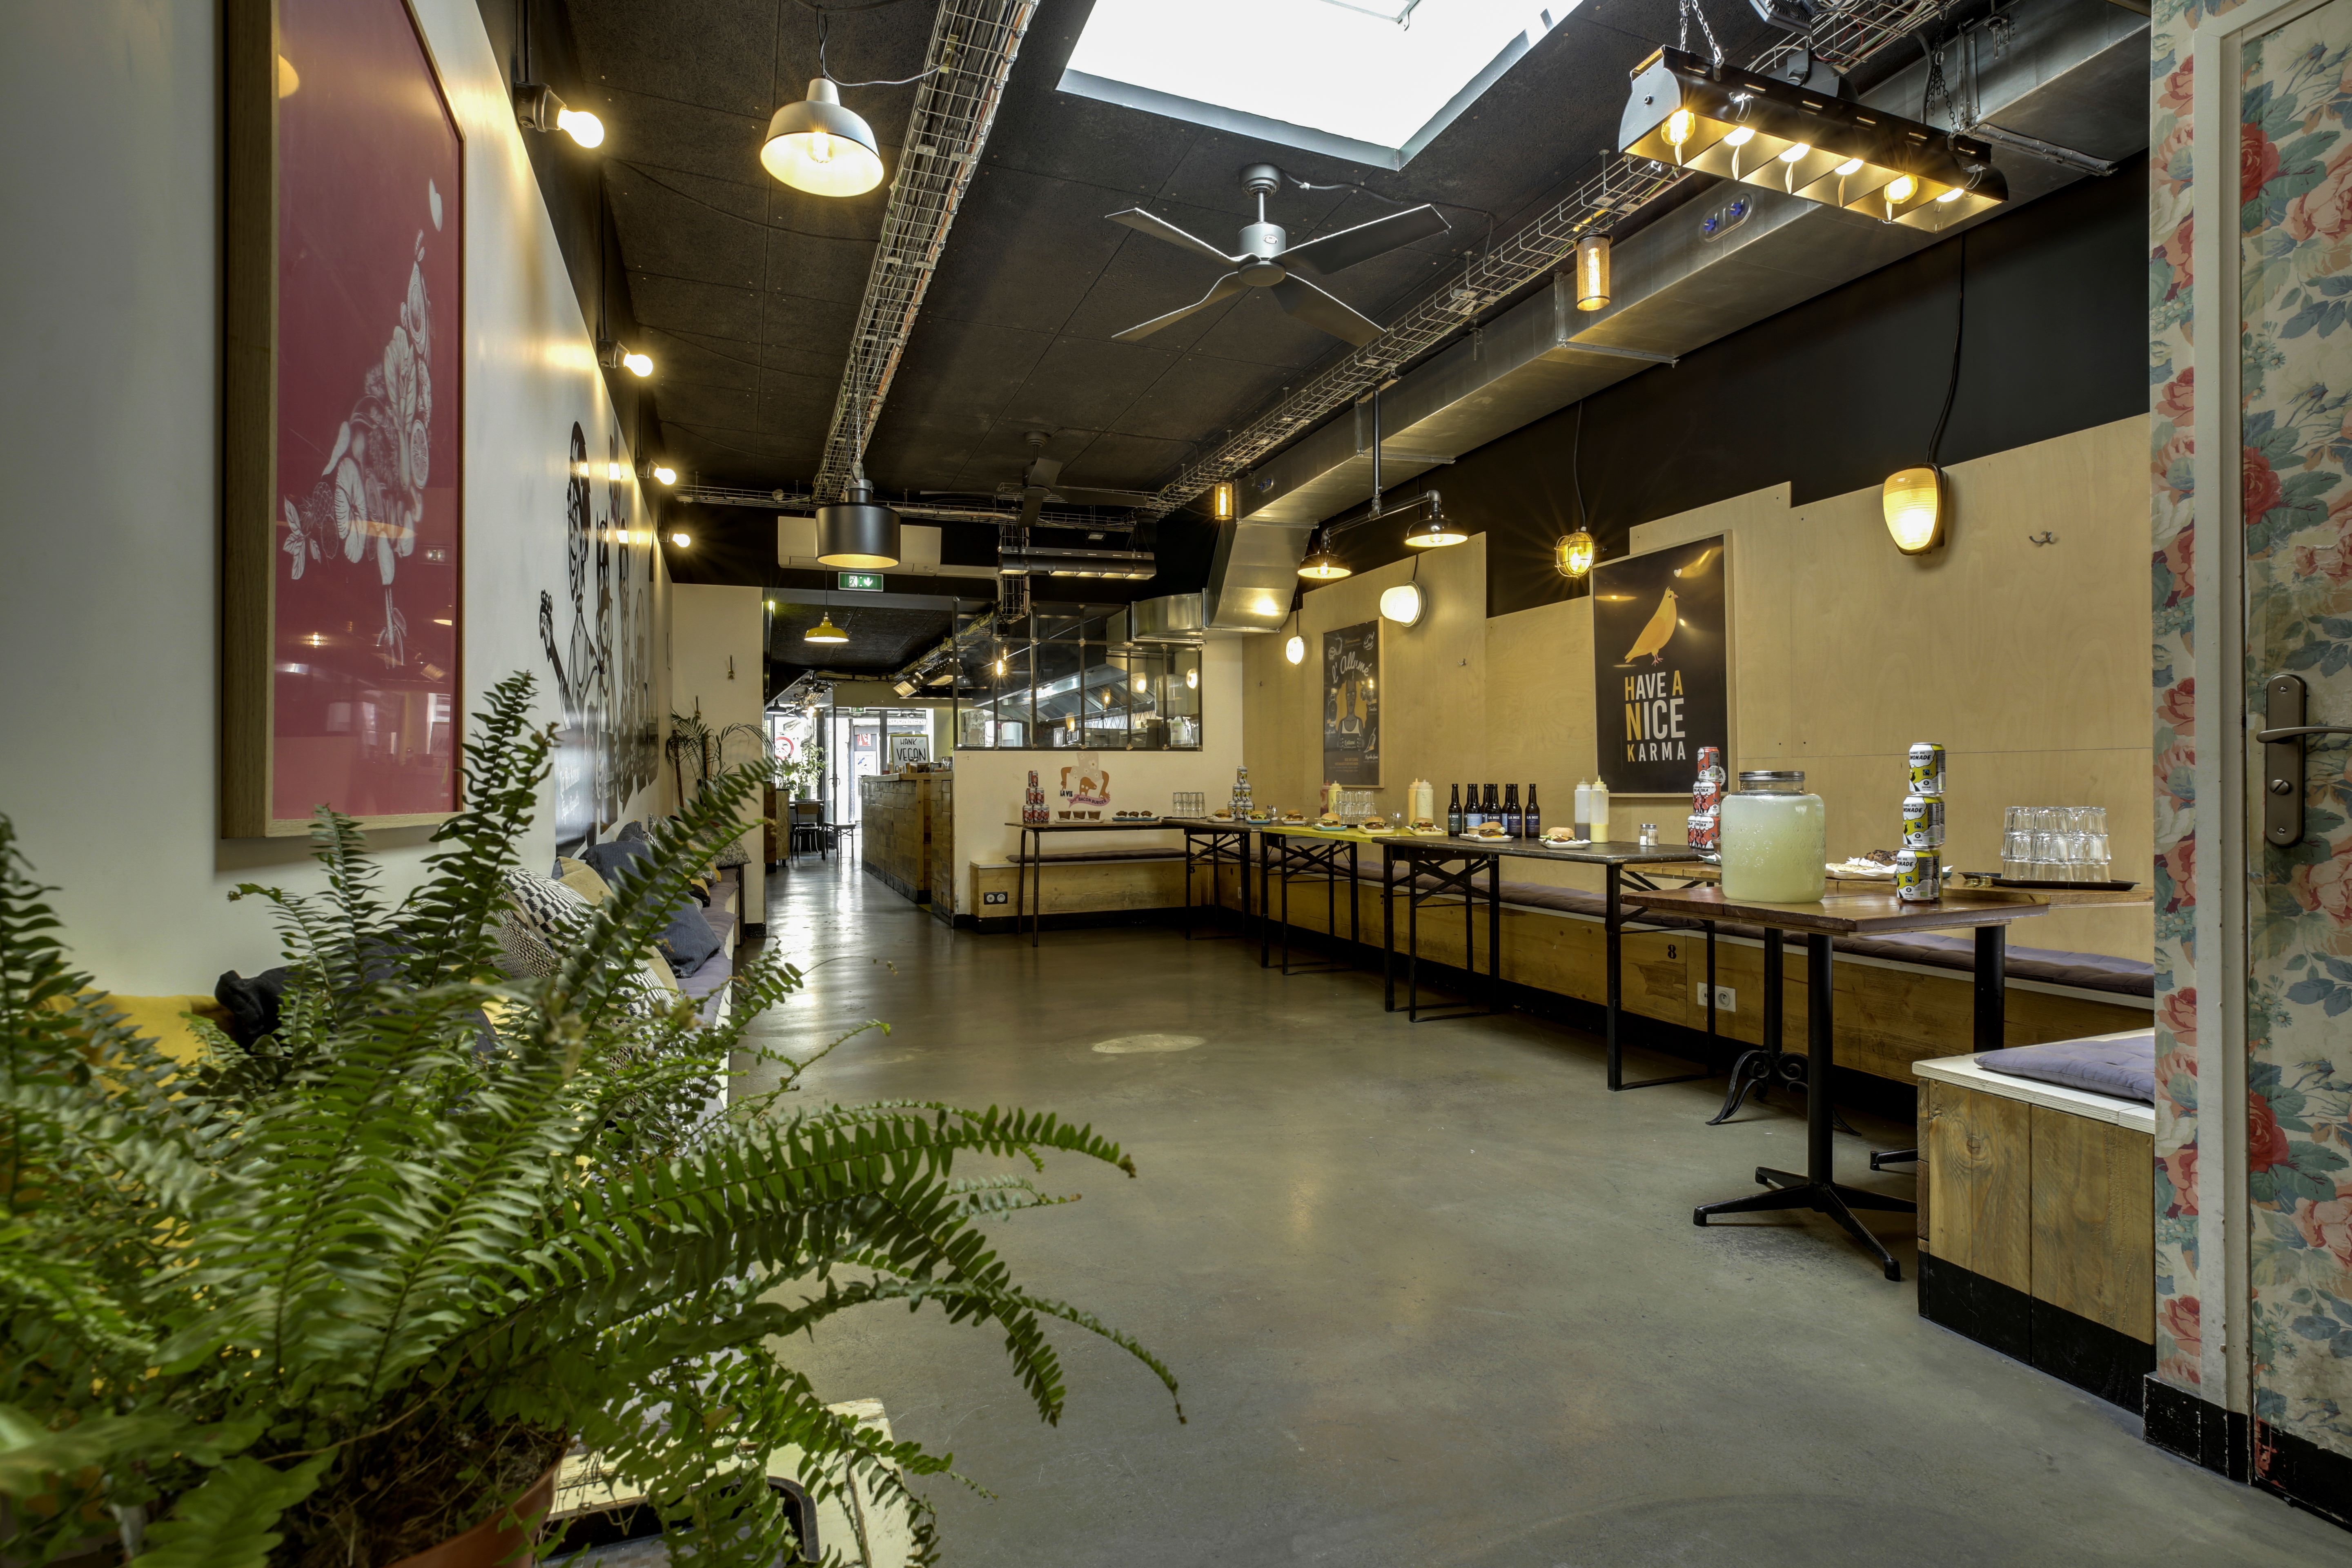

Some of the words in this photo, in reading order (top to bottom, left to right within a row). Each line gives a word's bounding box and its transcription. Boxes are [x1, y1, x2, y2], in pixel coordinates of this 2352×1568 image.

[1624, 672, 1666, 702] HAVE
[1672, 670, 1683, 696] A
[1625, 698, 1686, 741] NICE
[896, 748, 926, 761] VEGAN
[1628, 741, 1686, 762] KARMA
[1667, 944, 1677, 959] 8
